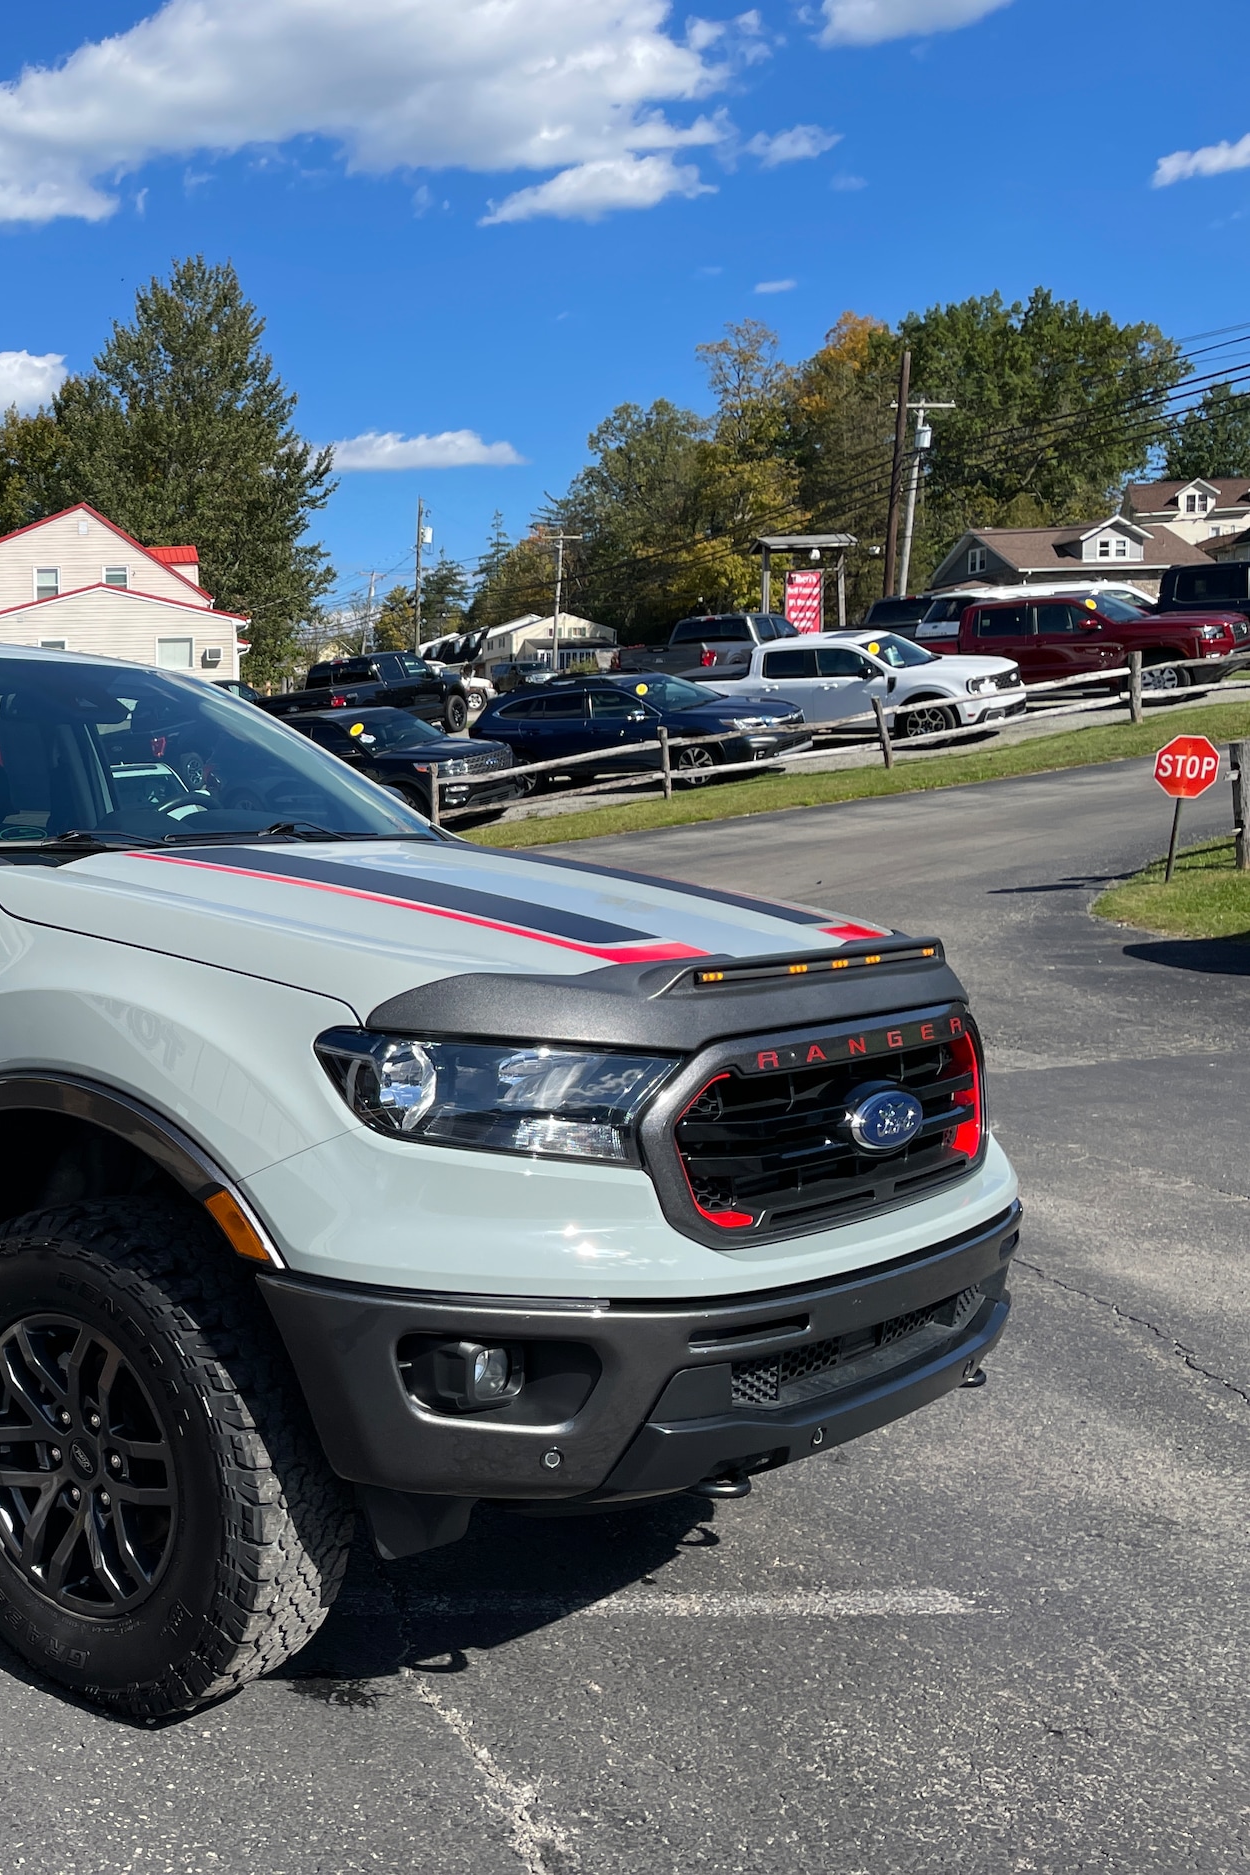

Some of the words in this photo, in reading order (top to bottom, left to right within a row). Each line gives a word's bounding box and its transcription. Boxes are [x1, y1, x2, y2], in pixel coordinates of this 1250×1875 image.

[1158, 751, 1217, 780] STOP
[757, 1017, 963, 1070] RANGER
[876, 1102, 916, 1138] Ford
